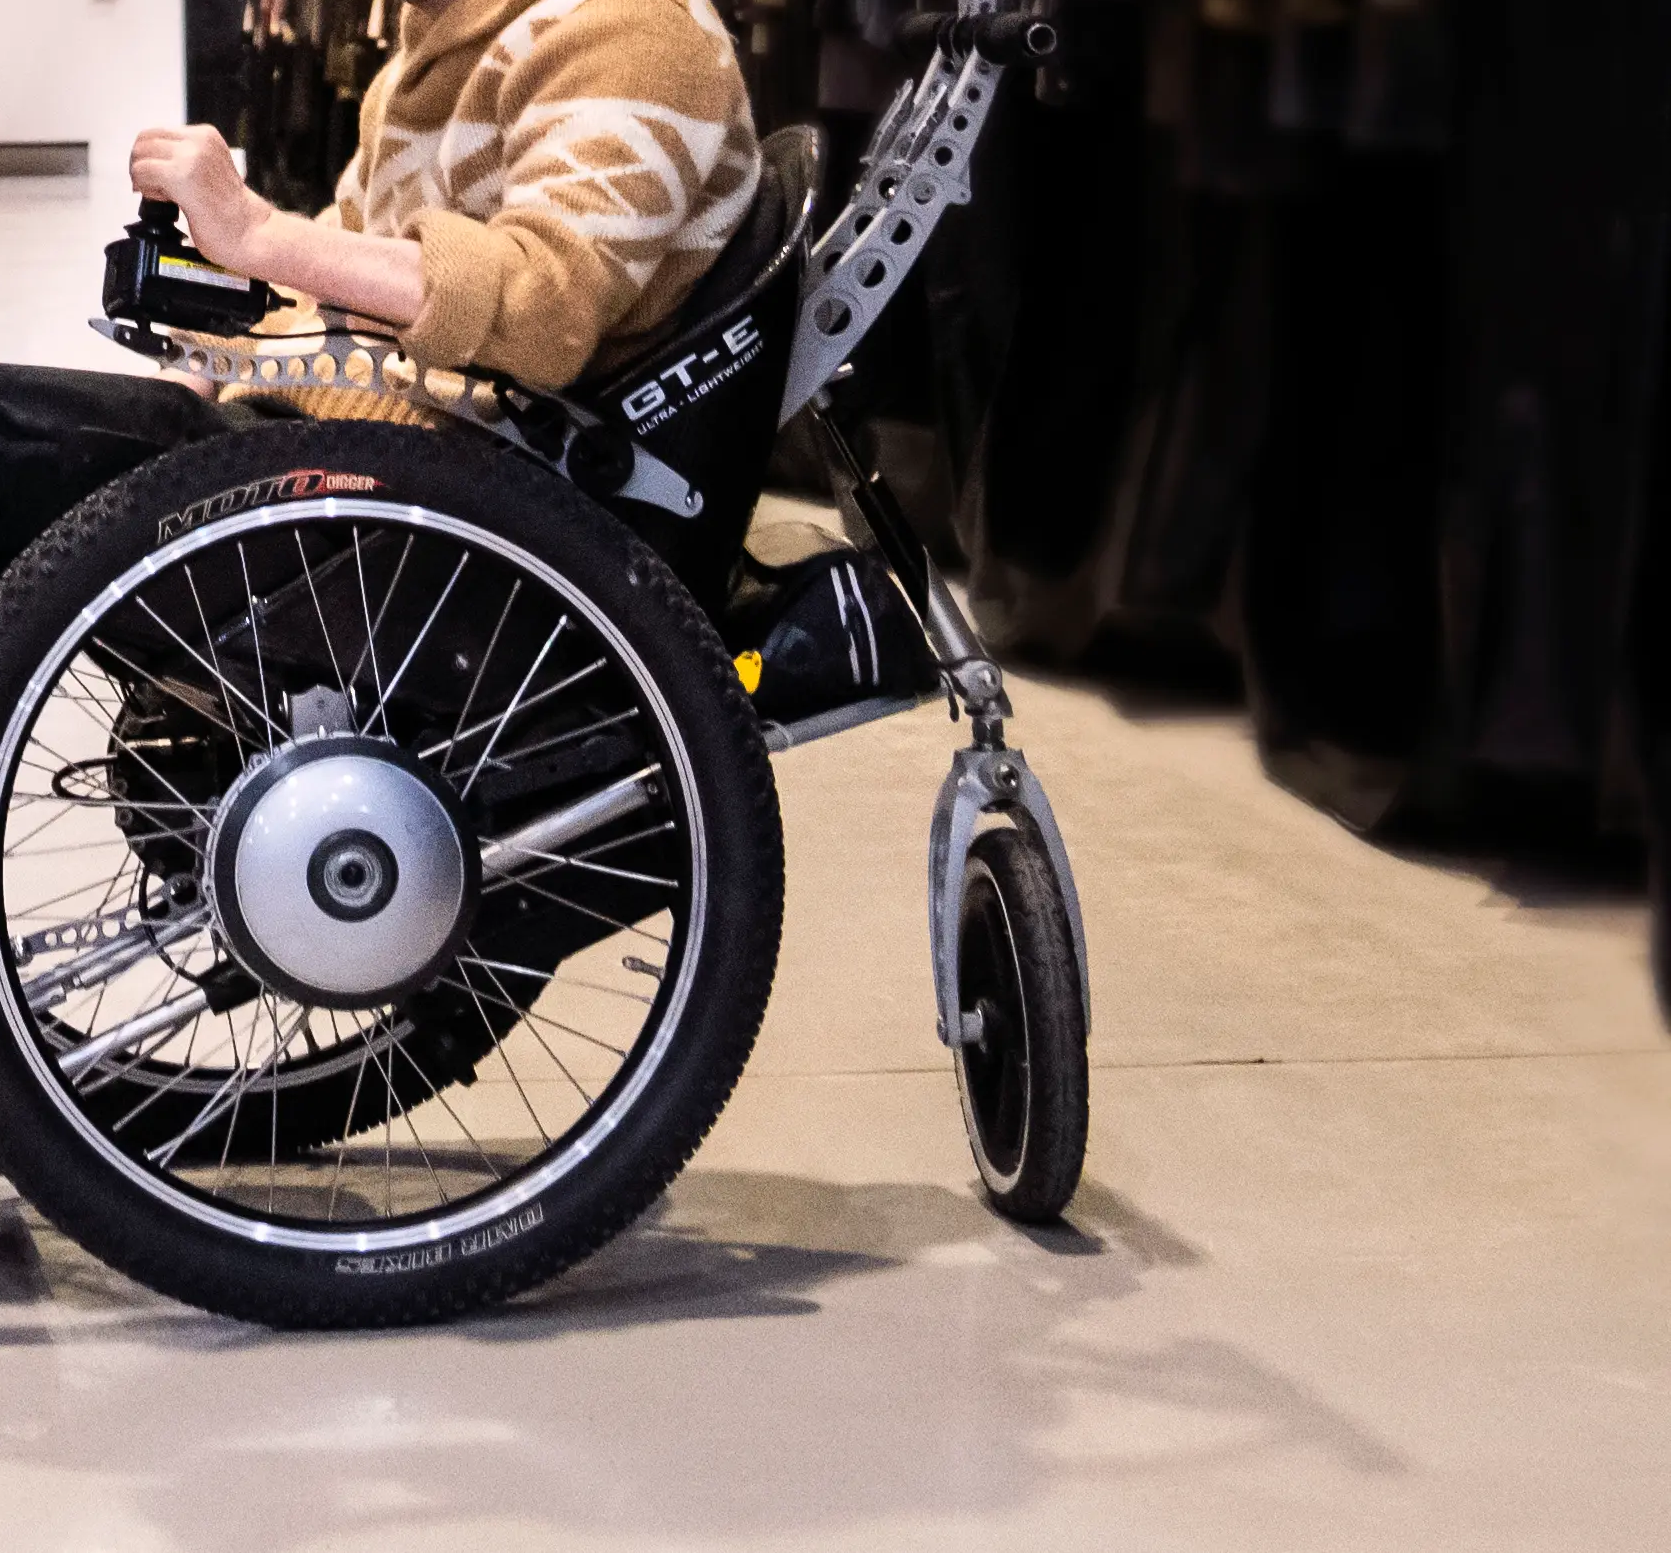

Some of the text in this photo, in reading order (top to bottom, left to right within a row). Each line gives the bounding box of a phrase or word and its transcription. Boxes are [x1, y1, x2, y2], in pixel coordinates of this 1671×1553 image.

[621, 314, 760, 422] GT-E
[636, 340, 764, 436] ULTRA LIGHTWEIGHT
[326, 474, 375, 492] DIGGER
